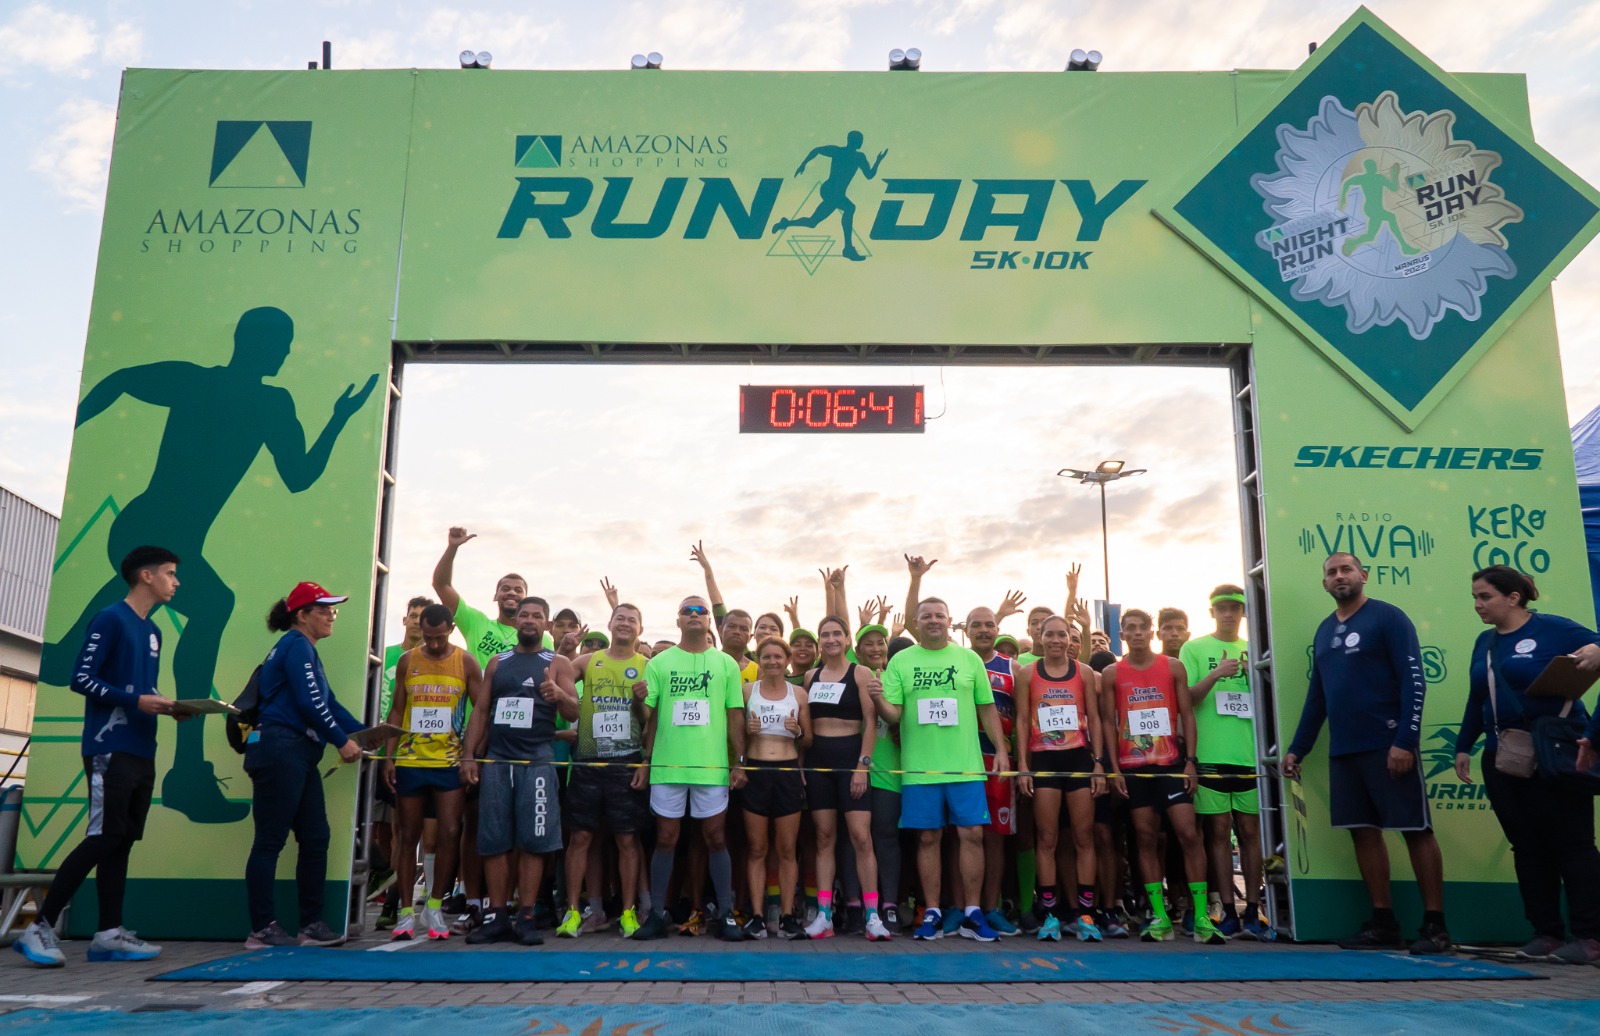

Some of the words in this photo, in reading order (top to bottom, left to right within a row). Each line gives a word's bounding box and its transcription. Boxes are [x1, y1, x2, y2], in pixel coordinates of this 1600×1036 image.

[570, 135, 729, 154] AMAZONAS
[569, 157, 729, 168] SHOPPING
[1416, 169, 1477, 205] RUN
[496, 177, 784, 239] RUN
[869, 178, 1149, 241] DAY
[1424, 186, 1482, 221] DAY
[145, 208, 361, 235] AMAZONAS
[1273, 217, 1349, 257] NIGHT
[141, 239, 358, 254] SHOPPING
[1280, 240, 1334, 271] RUN
[1394, 255, 1430, 271] MANAUS
[1404, 263, 1427, 275] 2022
[1294, 445, 1545, 470] SKECHERS
[1336, 512, 1392, 521] RADIO
[1468, 503, 1547, 539] KERO
[1316, 524, 1417, 558] VIVA
[1473, 541, 1550, 578] COCO
[1377, 565, 1411, 585] FM
[913, 671, 943, 679] RUN
[670, 685, 698, 693] DAY
[913, 679, 942, 687] DAY
[813, 691, 835, 700] 1997
[1128, 693, 1164, 702] Runners
[1223, 703, 1249, 711] 1623
[500, 710, 525, 721] 1978
[682, 712, 700, 721] 759
[929, 710, 948, 719] 719
[418, 720, 444, 728] 1260
[1046, 717, 1071, 727] 1514
[1140, 720, 1160, 730] 908
[600, 724, 623, 733] 1031
[535, 776, 547, 836] adidas
